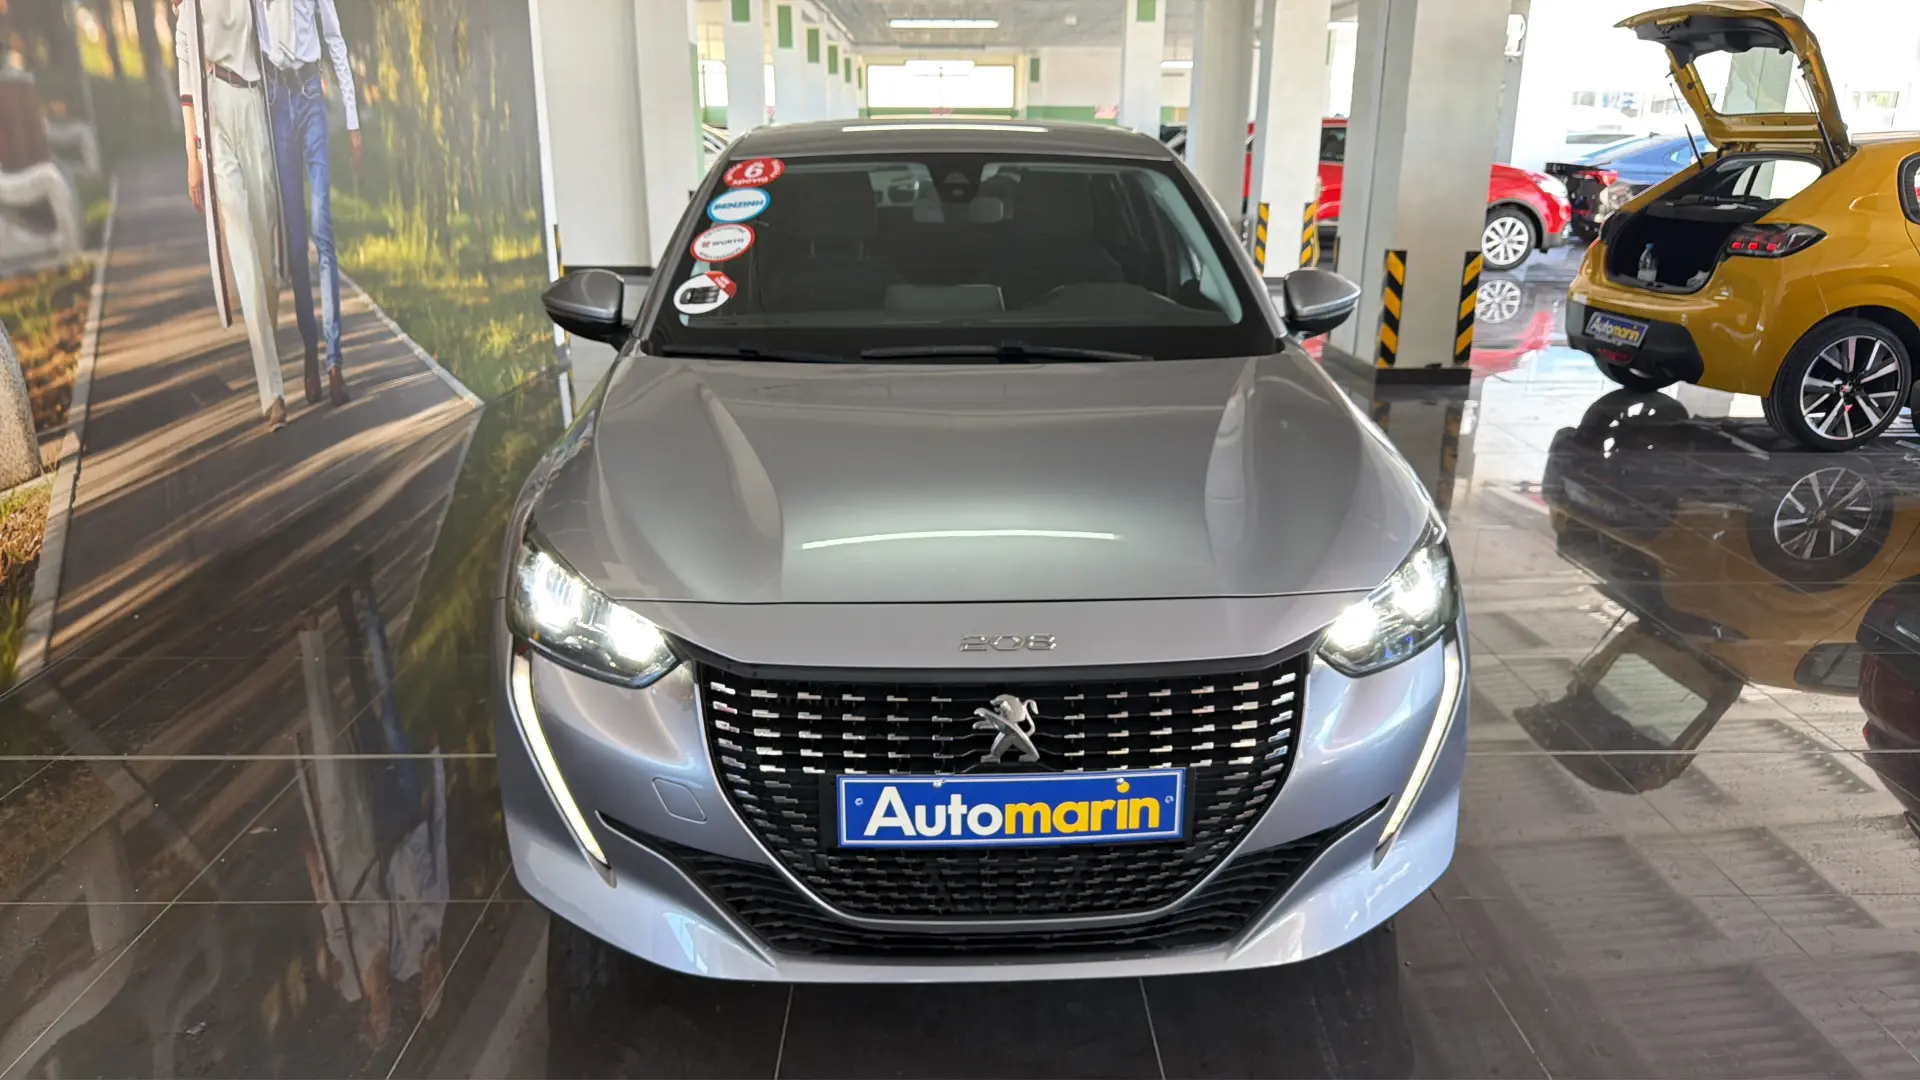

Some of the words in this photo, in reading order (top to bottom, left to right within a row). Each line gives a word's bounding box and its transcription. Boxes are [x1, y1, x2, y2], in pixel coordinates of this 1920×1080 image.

[744, 160, 765, 179] 6
[1590, 316, 1640, 342] Automarin
[959, 633, 1057, 651] 208
[863, 780, 1160, 837] Automarin
